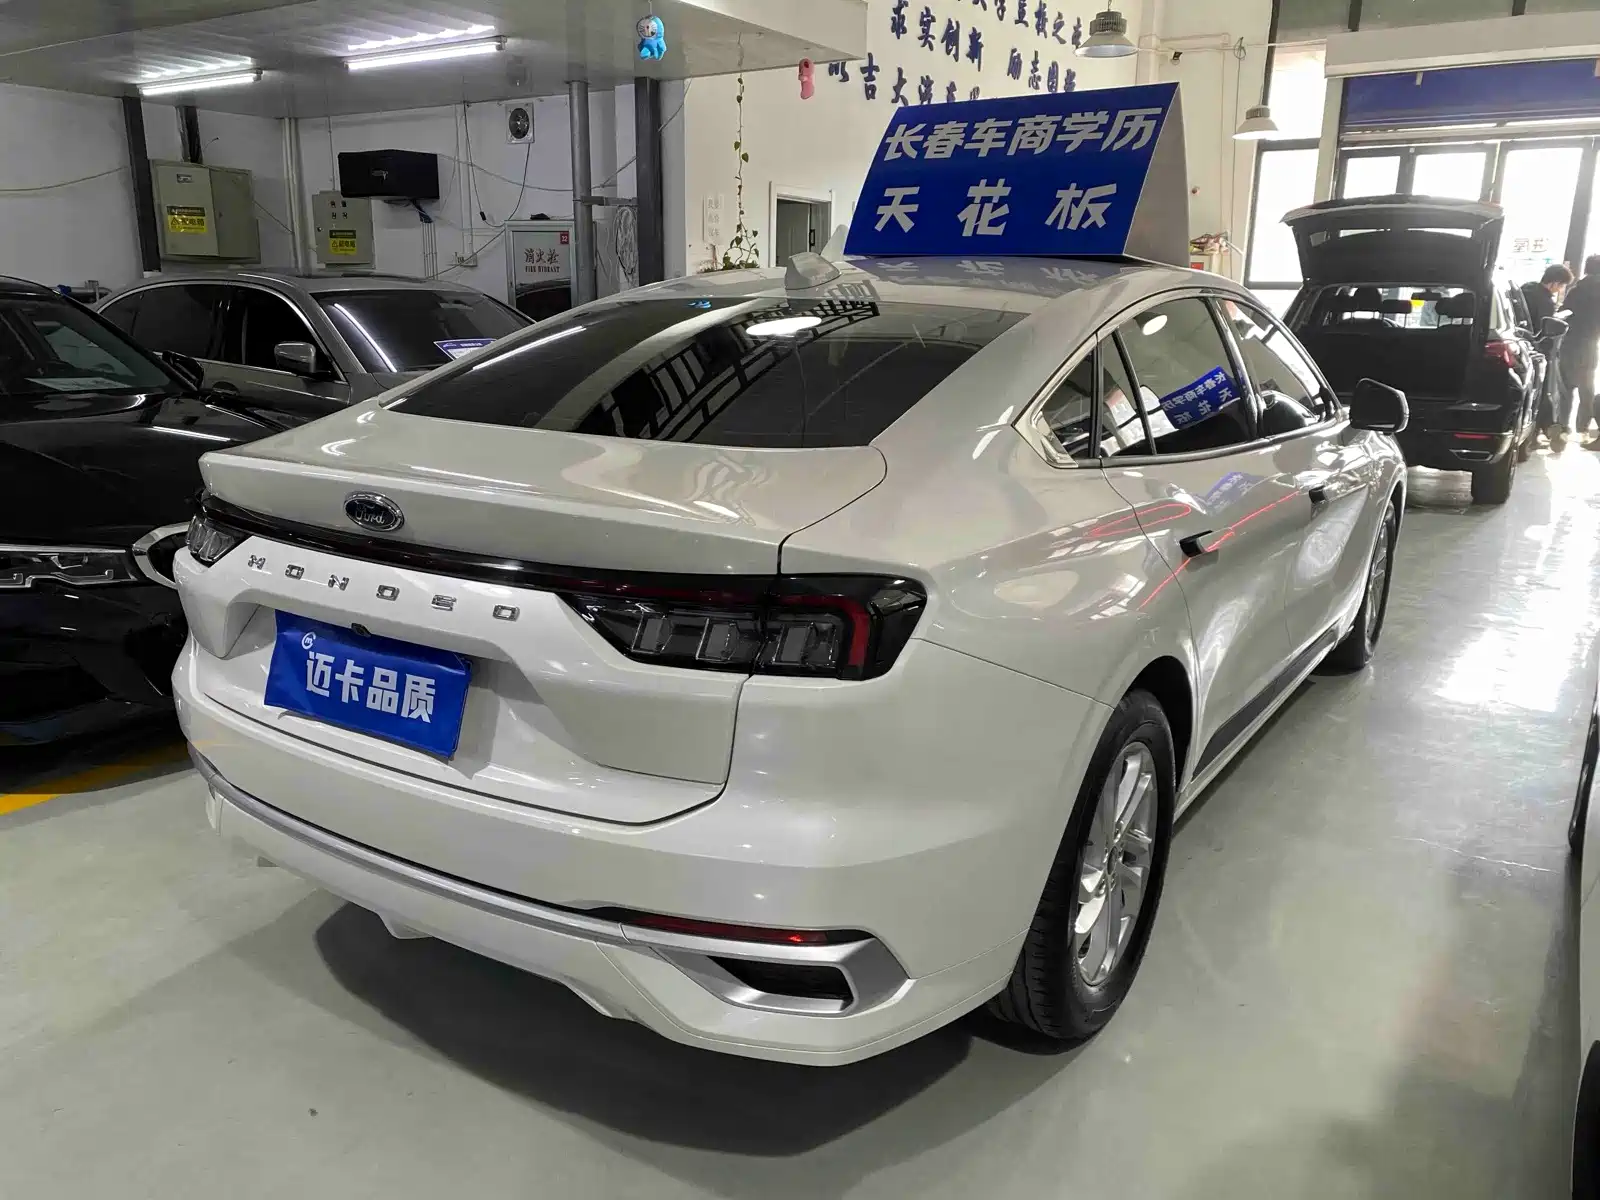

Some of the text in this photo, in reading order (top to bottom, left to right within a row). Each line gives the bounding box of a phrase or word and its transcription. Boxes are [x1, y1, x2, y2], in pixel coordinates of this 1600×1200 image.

[884, 107, 1162, 162] 长春车商学历
[874, 178, 1117, 237] 天花板
[306, 651, 436, 723] 迈卡品质
